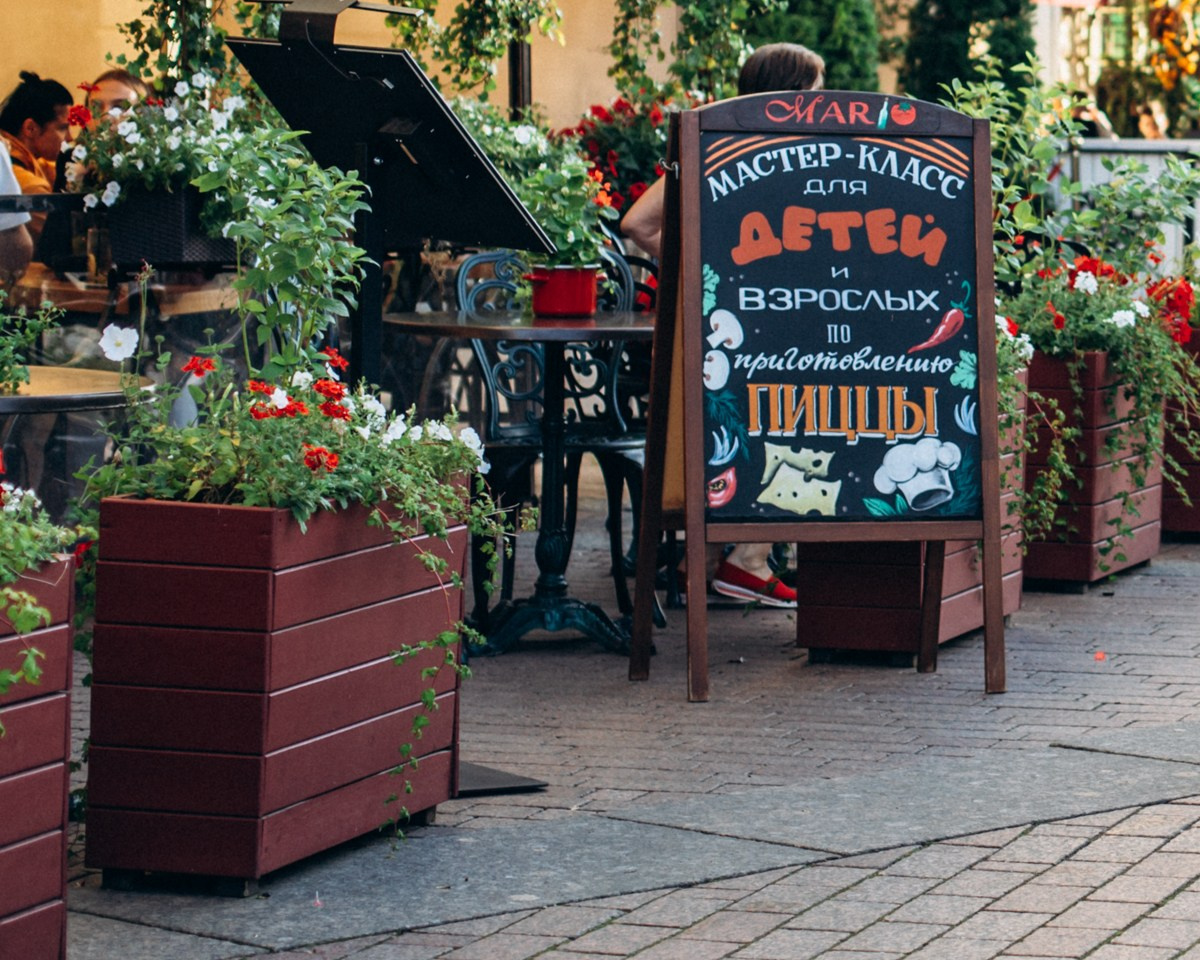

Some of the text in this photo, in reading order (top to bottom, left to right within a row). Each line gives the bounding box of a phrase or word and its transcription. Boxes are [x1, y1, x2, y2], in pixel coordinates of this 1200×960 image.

[706, 142, 965, 202] МАСТЕР-КЛАСС
[731, 205, 948, 266] ДЕТЕЙ
[738, 287, 940, 311] ВЗРОСЛЫХ
[734, 346, 954, 379] приготовлению
[747, 383, 939, 445] ПИЦЦЫ
